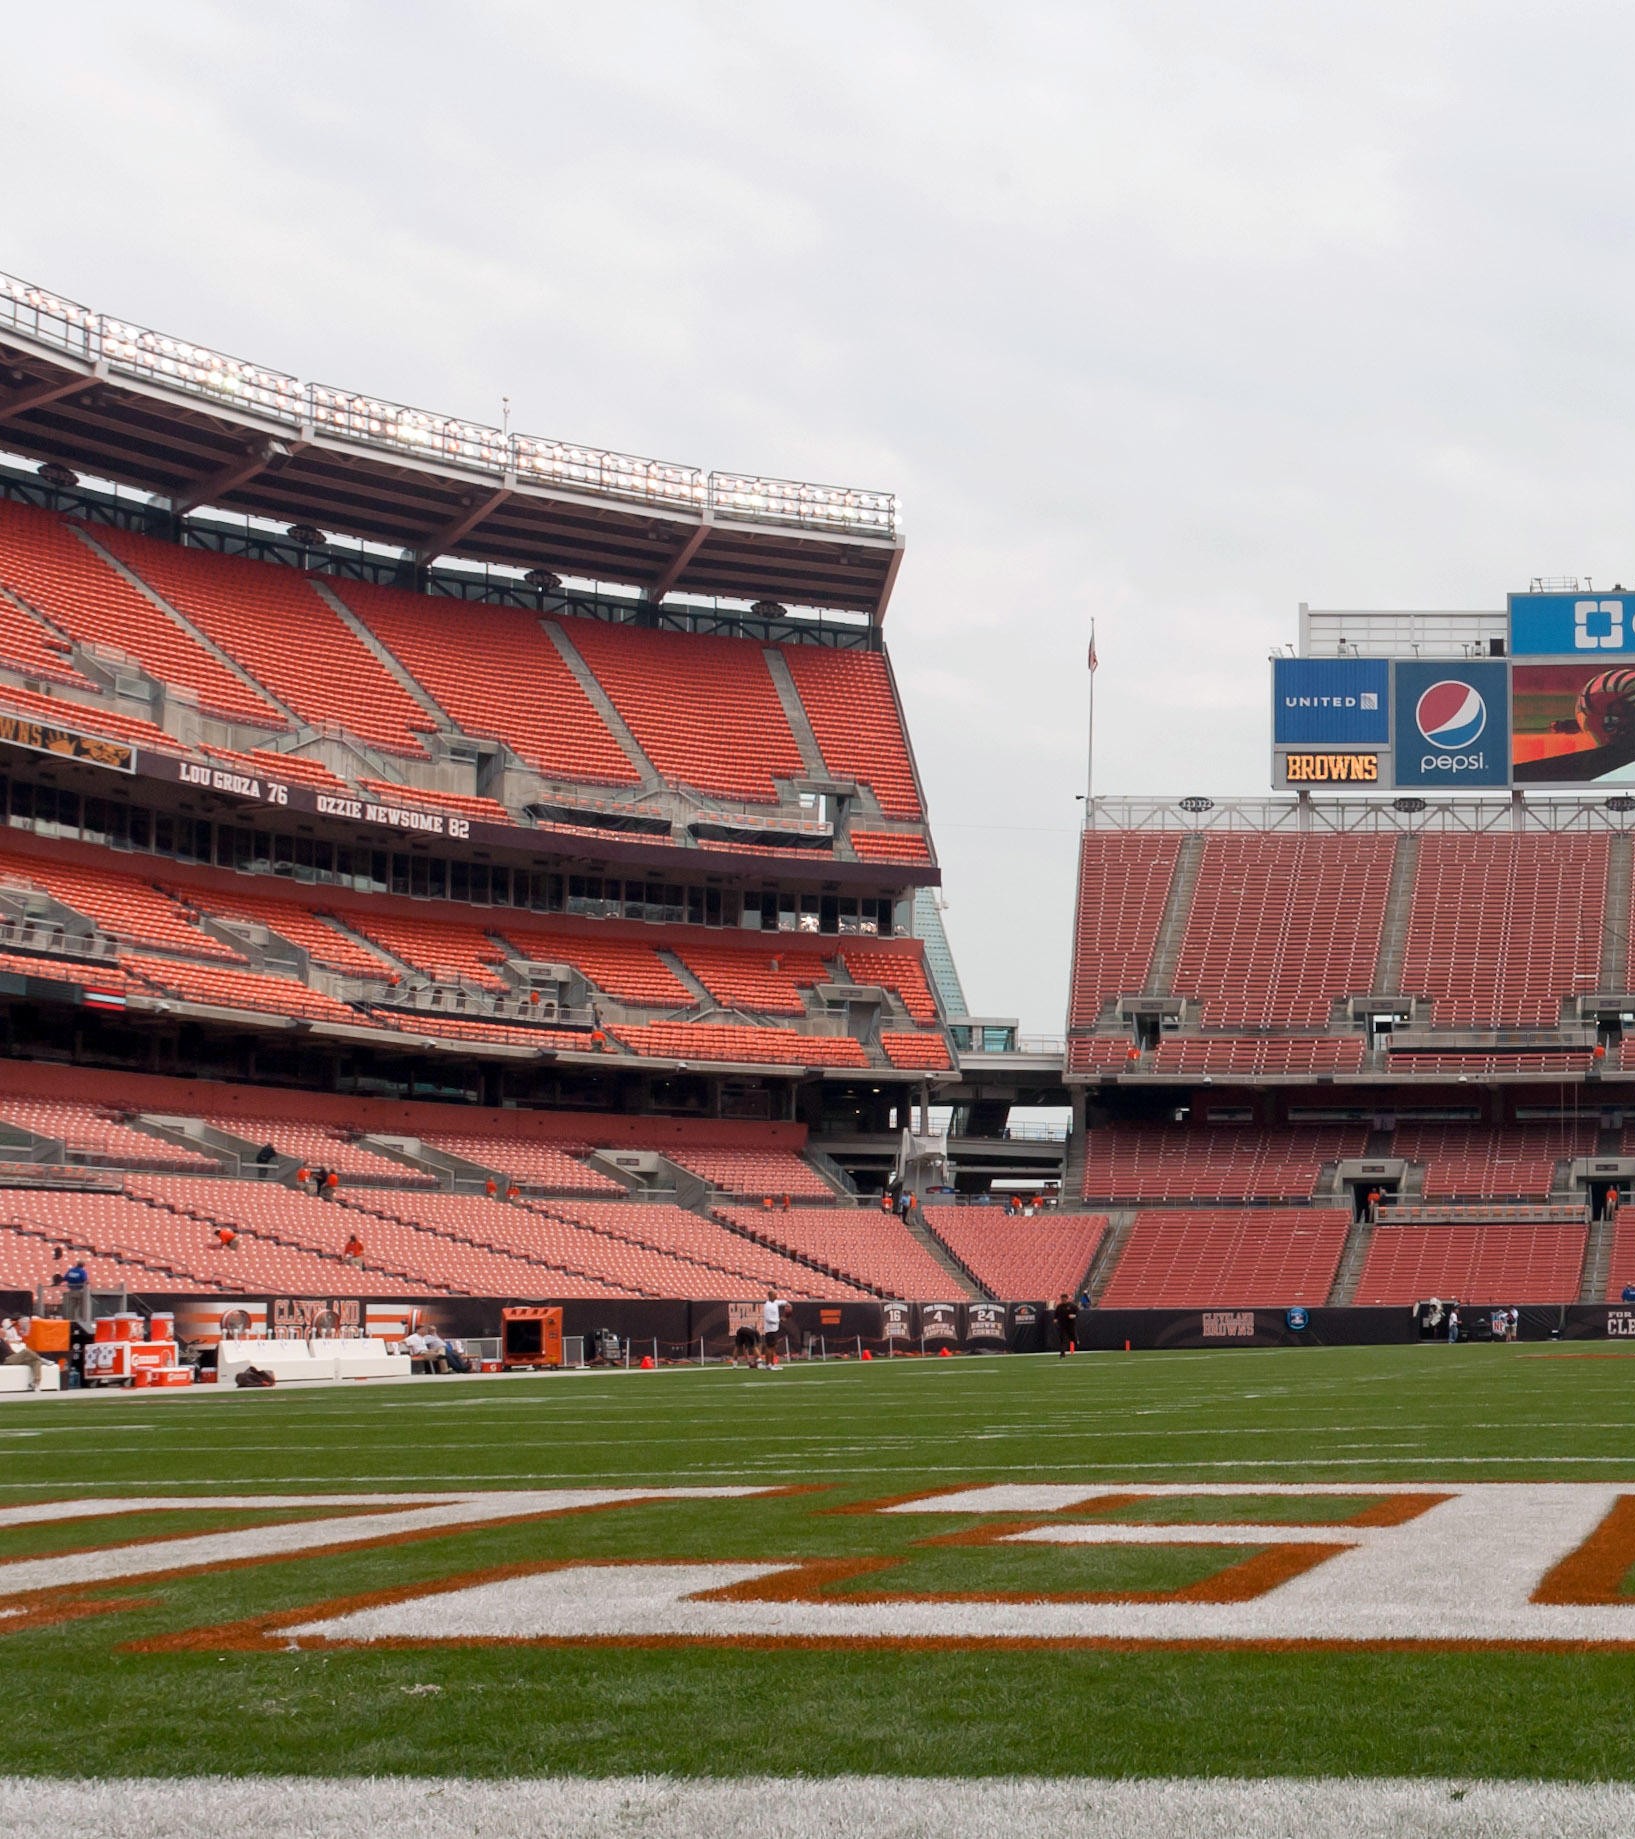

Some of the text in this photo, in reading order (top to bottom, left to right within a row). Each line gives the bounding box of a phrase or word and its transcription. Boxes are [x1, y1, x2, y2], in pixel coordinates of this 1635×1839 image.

[1285, 696, 1356, 708] UNITED
[1287, 754, 1378, 781] BROWNS
[1420, 751, 1484, 774] pepsi
[179, 762, 288, 806] LOU GROZA 76
[317, 795, 469, 839] OZZIE NEWSOME 82
[889, 1310, 901, 1322] 16
[933, 1310, 943, 1322] 4
[978, 1310, 995, 1322] 24
